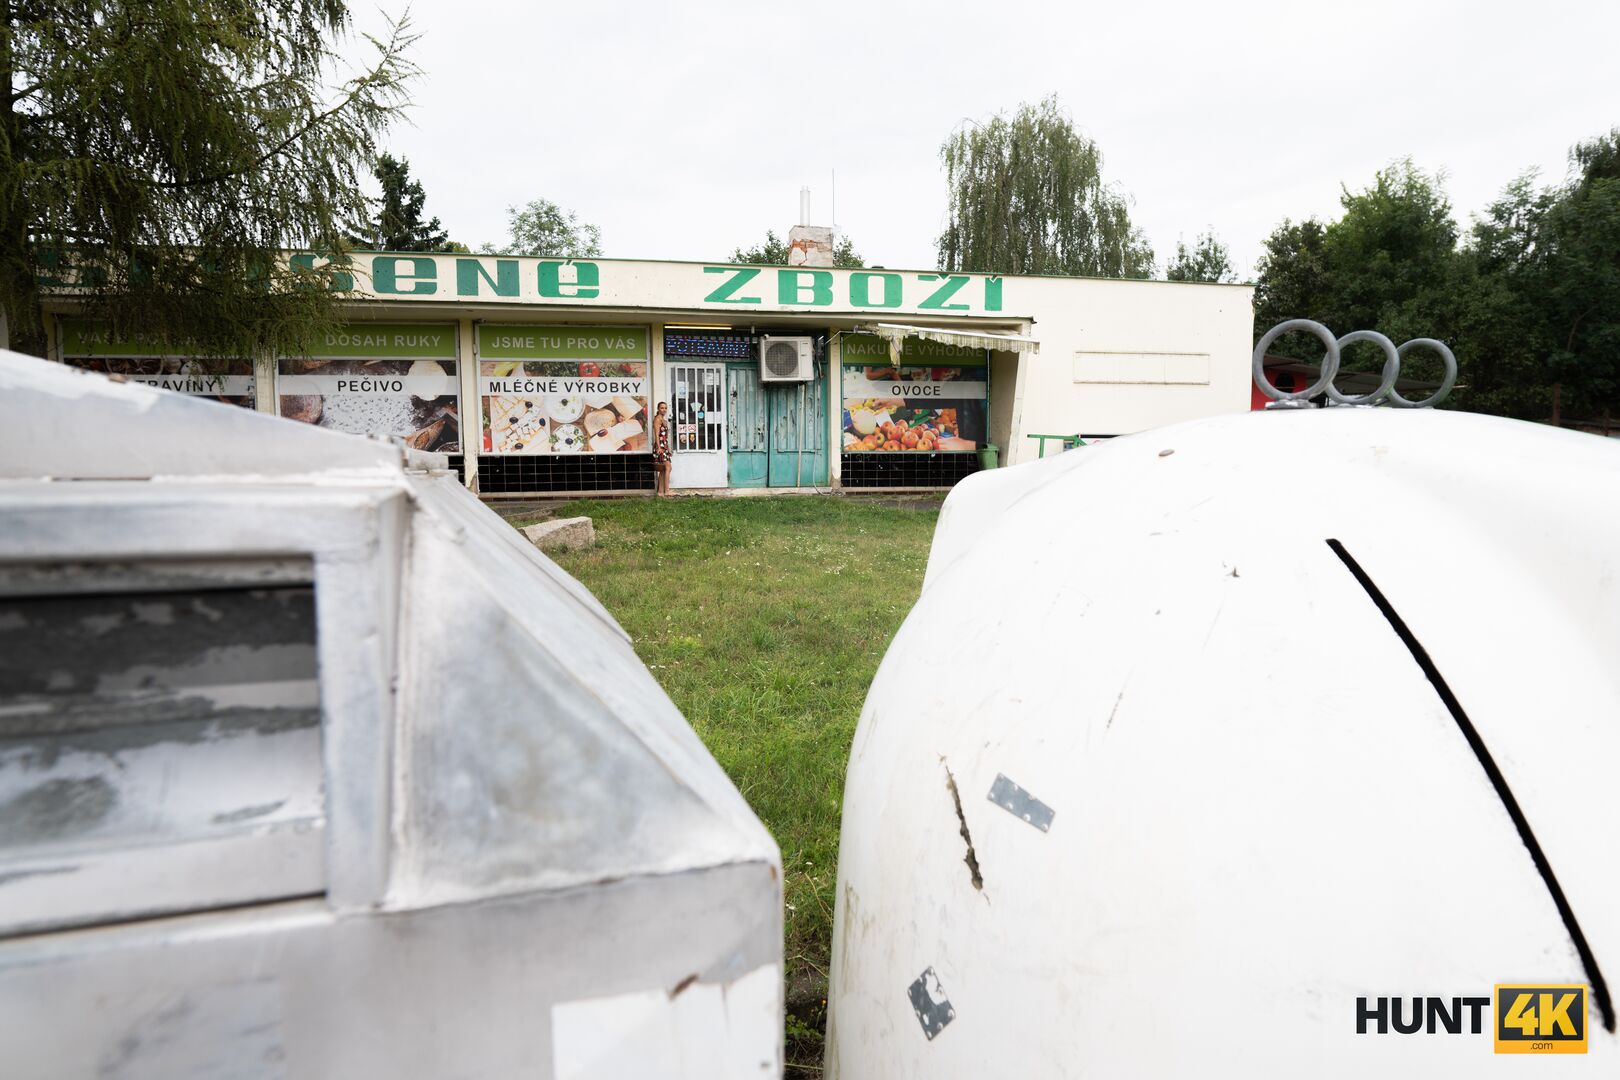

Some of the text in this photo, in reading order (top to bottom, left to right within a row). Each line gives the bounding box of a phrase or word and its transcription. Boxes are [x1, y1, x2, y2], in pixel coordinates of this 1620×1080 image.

[703, 266, 1003, 311] ZBOŽÍ
[325, 334, 441, 348] DOSAH RUKY
[491, 335, 636, 350] JSME TU PRO VÁS
[337, 376, 403, 392] PEČIVO
[489, 378, 641, 393] MLÉČNÉ VÝROBKY
[891, 384, 941, 396] OVOCE
